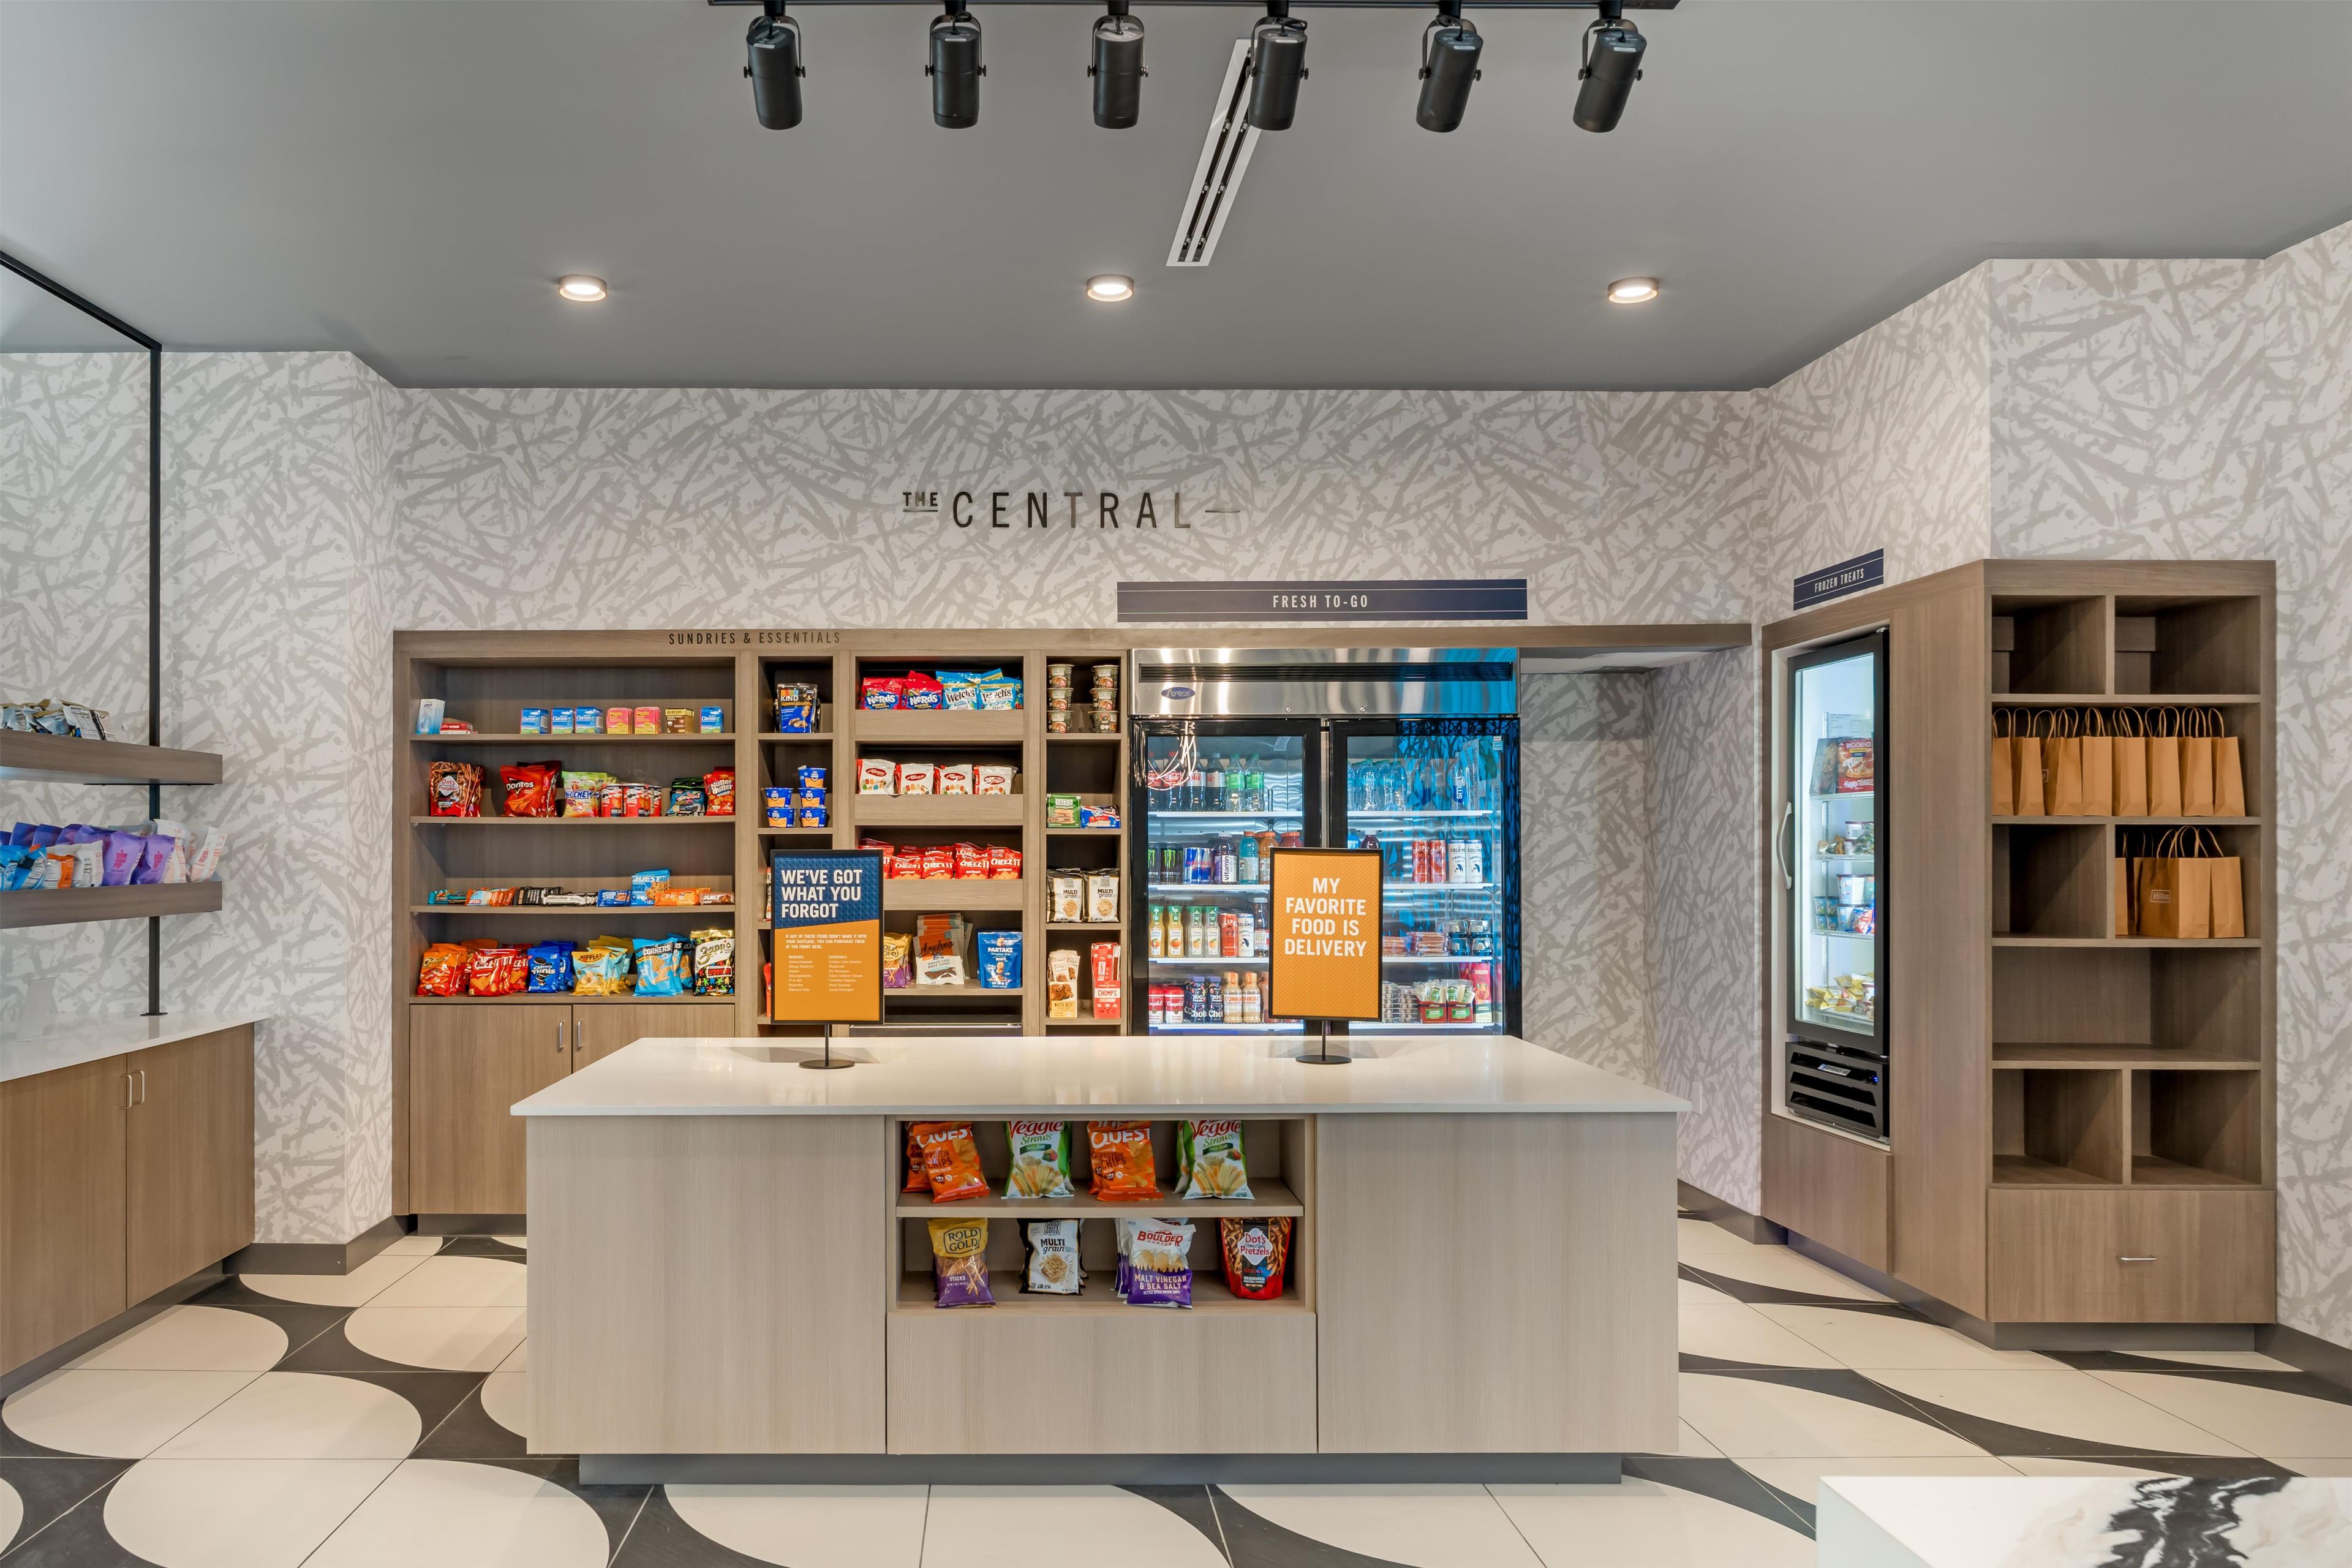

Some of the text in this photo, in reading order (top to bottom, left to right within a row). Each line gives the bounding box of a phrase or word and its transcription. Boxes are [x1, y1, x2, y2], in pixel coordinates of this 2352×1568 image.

[903, 491, 1191, 529] THE CENTRAL
[1814, 568, 1864, 593] FROZEN TREATS
[1273, 594, 1369, 608] FRESH TO-GO
[669, 631, 840, 644] SUNDRIES & ESSENTIALS
[946, 689, 975, 703] Welch's
[506, 780, 534, 791] Doritos
[710, 779, 732, 788] Nutter
[712, 784, 733, 795] Butter
[781, 869, 863, 884] WE'VE GOT
[1313, 877, 1341, 894] MY
[781, 886, 861, 901] WHAT YOU
[781, 903, 839, 918] FORGOT
[1286, 897, 1366, 915] FAVORITE
[1291, 918, 1360, 936] FOOD IS
[697, 941, 731, 965] Zapp's
[1284, 939, 1366, 957] DELIVERY
[1010, 1121, 1063, 1139] Veggie
[1190, 1120, 1242, 1142] Veggie
[916, 1128, 973, 1149] QUEST
[1020, 1134, 1052, 1145] Straws
[1091, 1128, 1150, 1148] QUEST
[1204, 1133, 1234, 1147] Straws
[948, 1229, 978, 1241] ROLD
[1137, 1230, 1183, 1246] BOULDER
[1245, 1233, 1266, 1243] Dot's
[949, 1239, 978, 1252] GOLD
[1040, 1238, 1065, 1247] MULTI
[1043, 1246, 1065, 1254] grain
[1240, 1246, 1270, 1256] Pretzels
[1134, 1274, 1153, 1283] MALT
